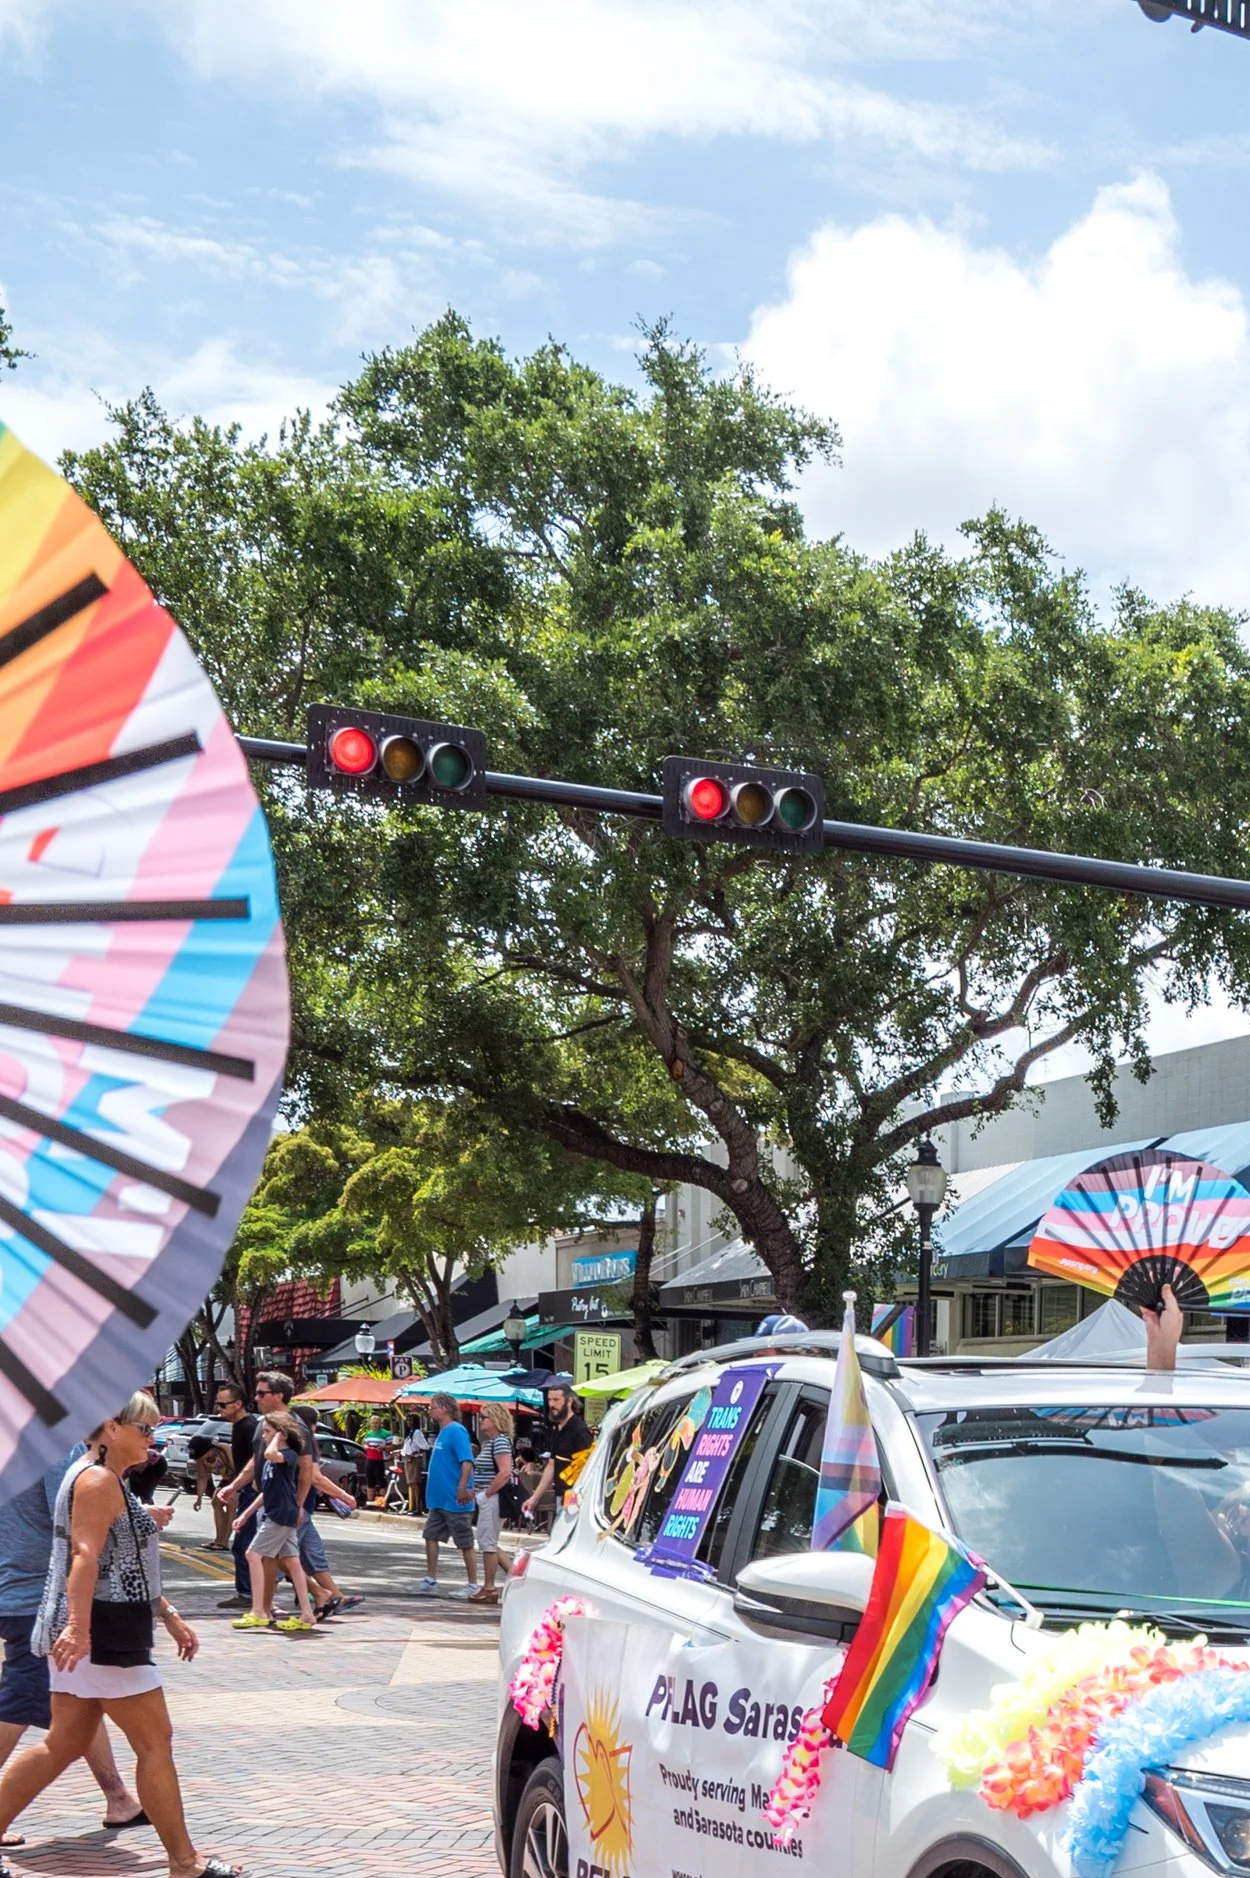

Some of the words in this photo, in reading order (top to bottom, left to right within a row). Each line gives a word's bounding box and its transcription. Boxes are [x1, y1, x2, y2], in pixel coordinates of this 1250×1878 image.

[1143, 1164, 1199, 1208] I'M
[1108, 1194, 1241, 1249] PROUD
[580, 1336, 617, 1347] SPEED
[583, 1348, 612, 1358] LIMIT
[584, 1362, 610, 1381] 15
[707, 1407, 742, 1429] TRANS
[695, 1434, 734, 1456] RIGHTS
[685, 1461, 710, 1483] ARE
[674, 1488, 713, 1512] HUMAN
[663, 1515, 700, 1539] RIGHTS
[723, 1687, 843, 1749] Saras
[702, 1776, 746, 1813] serving
[673, 1807, 695, 1830] and
